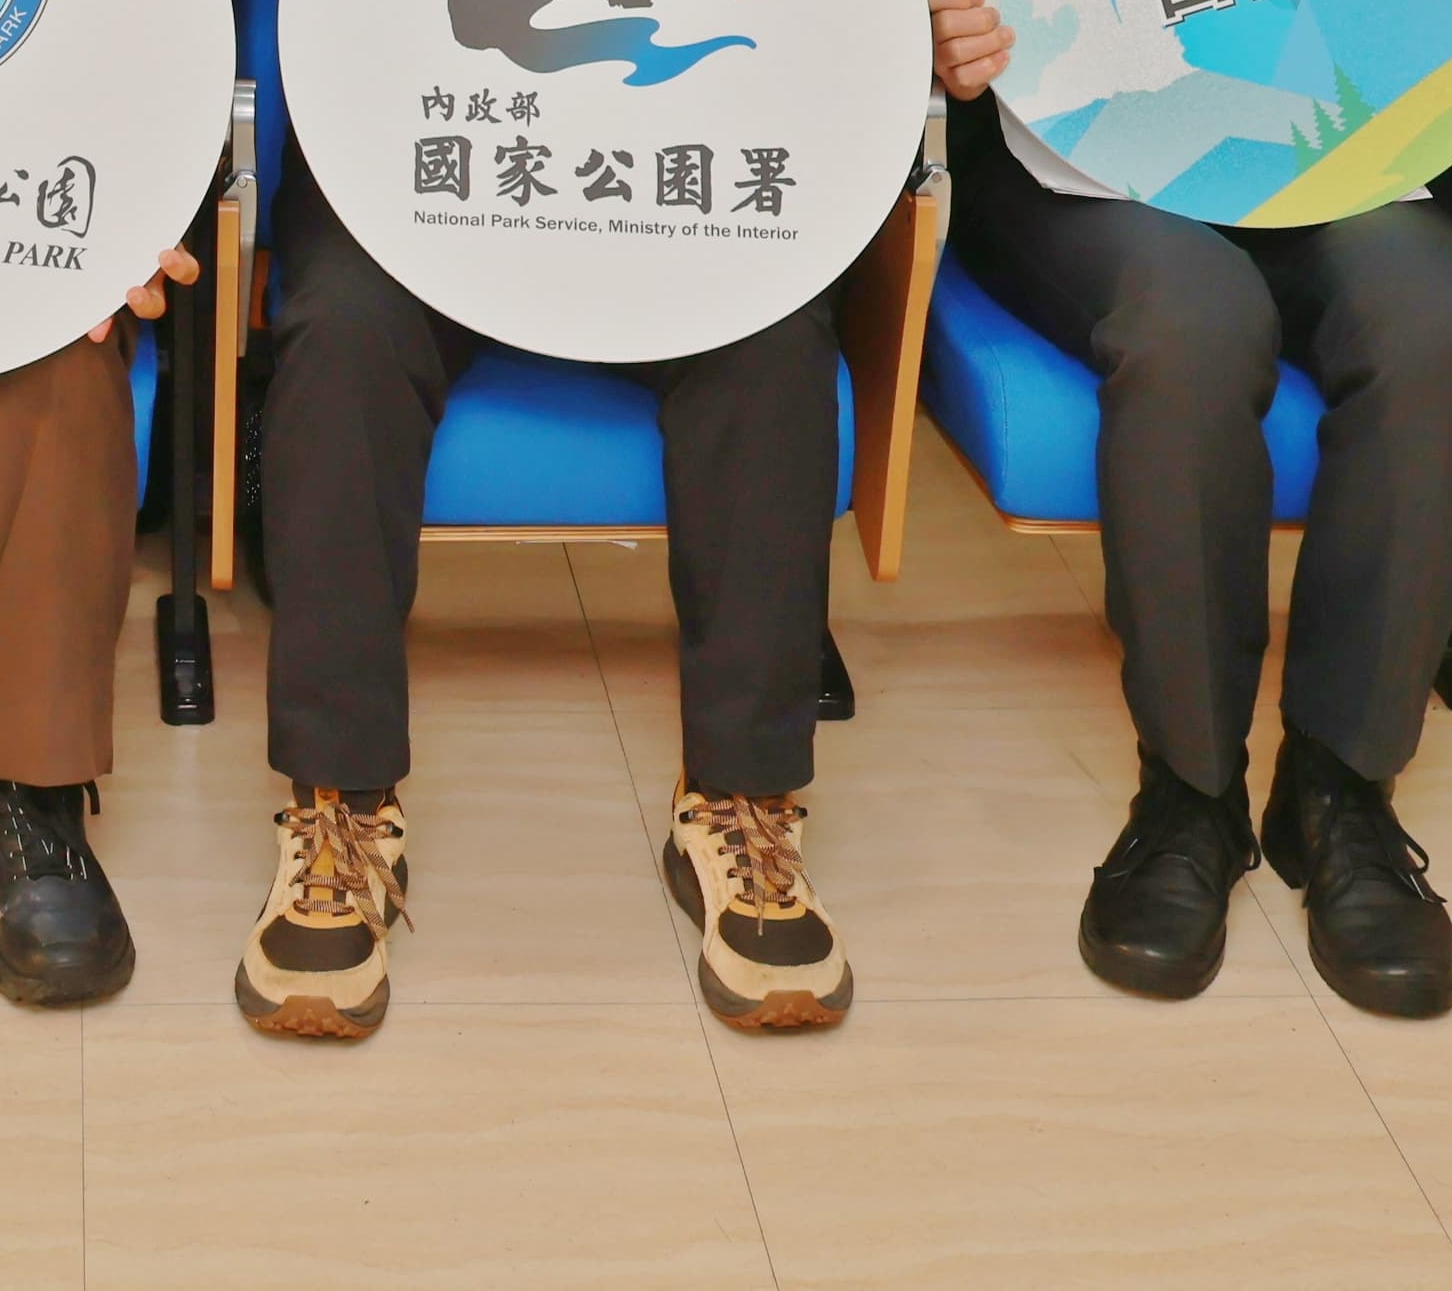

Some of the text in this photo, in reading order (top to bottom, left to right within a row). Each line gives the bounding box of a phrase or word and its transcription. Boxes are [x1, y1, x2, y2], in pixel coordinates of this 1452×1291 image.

[413, 134, 798, 217] 國家公園署
[413, 210, 799, 241] National Park Service, Ministry of the Interior
[2, 240, 88, 272] PARK
